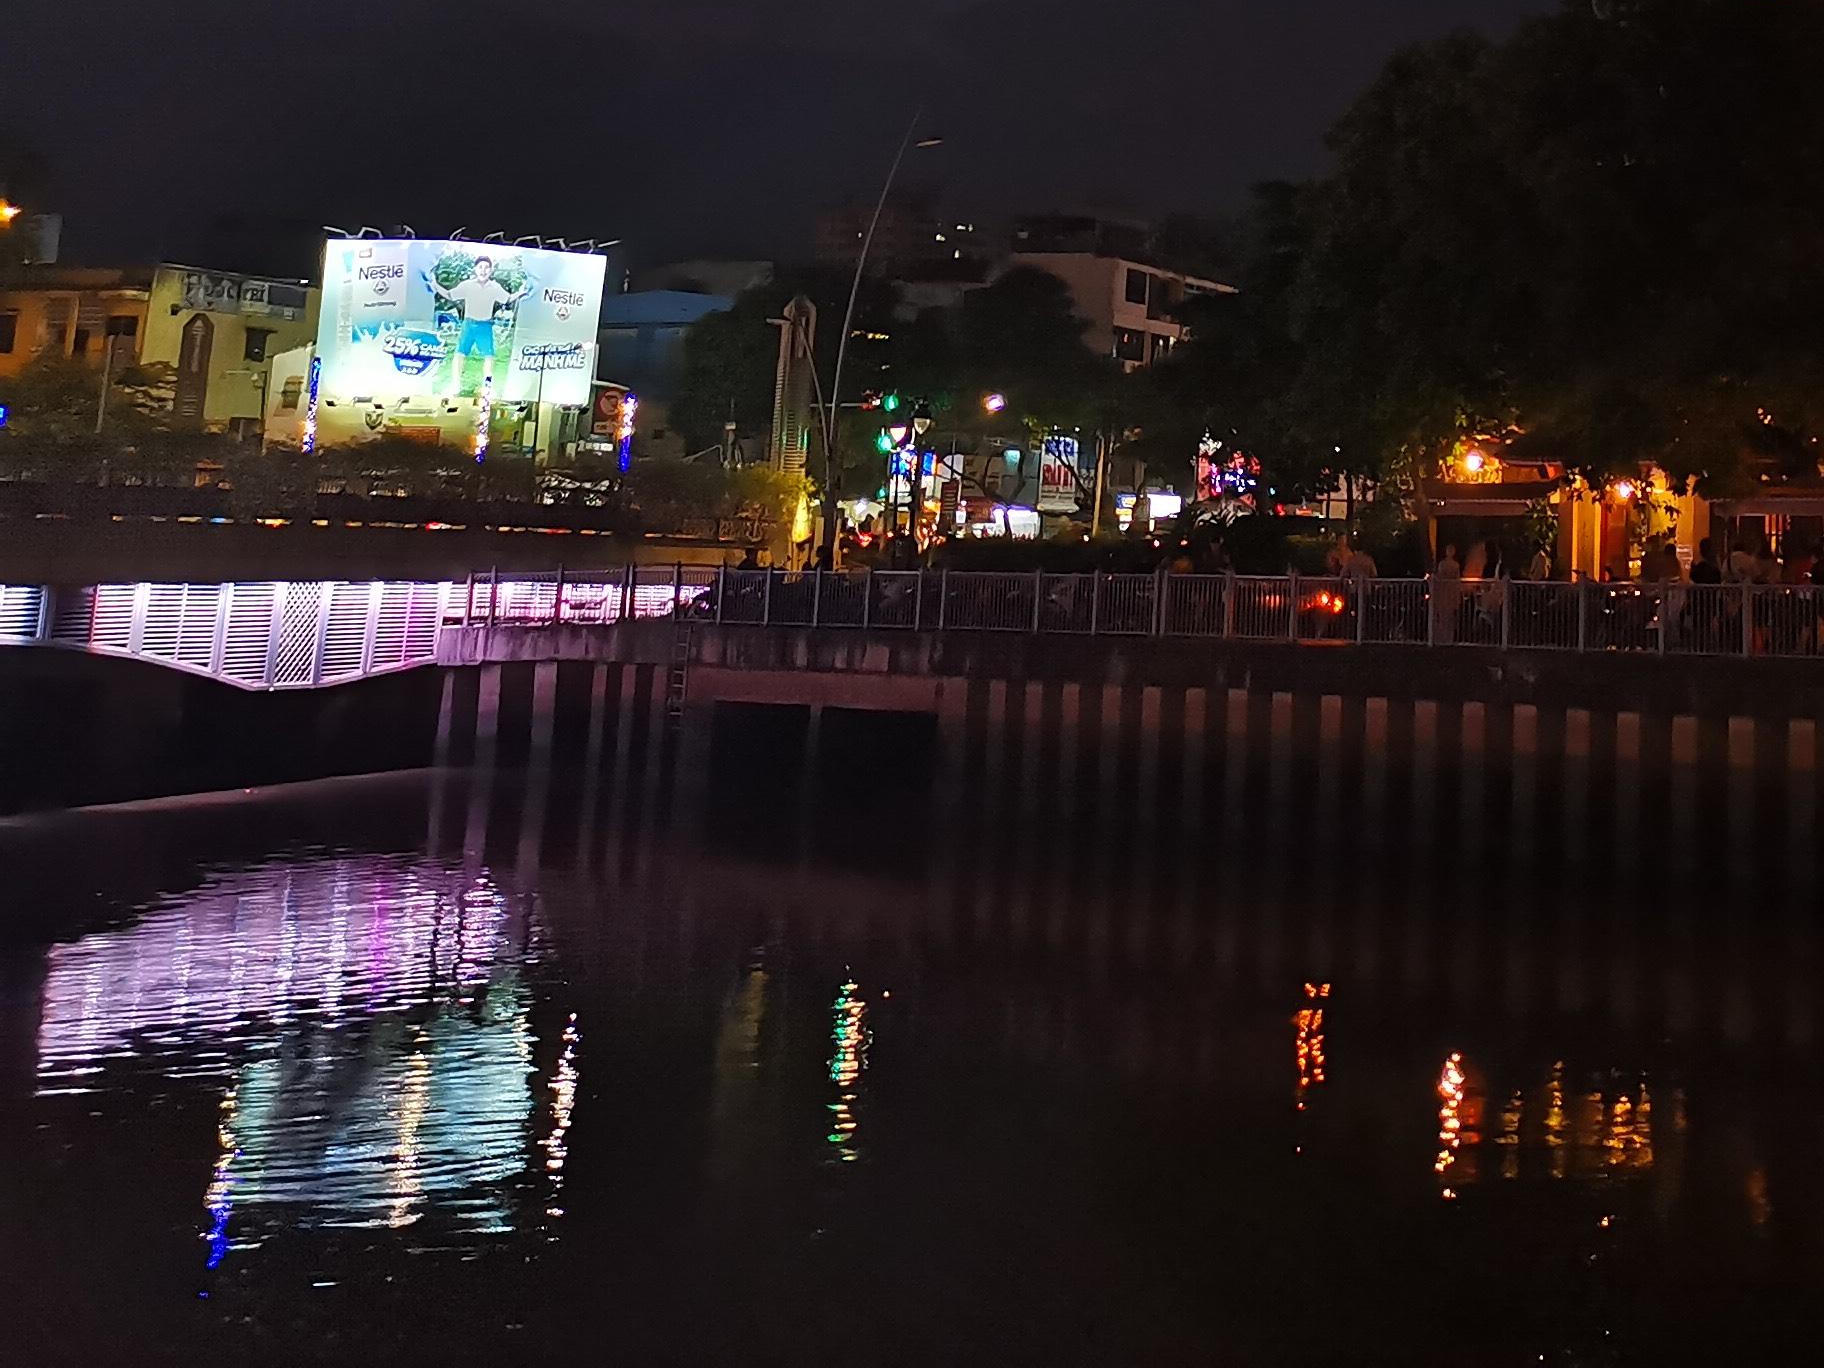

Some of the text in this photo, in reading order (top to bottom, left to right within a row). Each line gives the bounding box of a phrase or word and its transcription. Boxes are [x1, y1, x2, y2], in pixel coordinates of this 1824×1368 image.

[359, 264, 404, 281] Nestlé
[543, 288, 584, 306] Nestlé
[384, 335, 421, 356] 25%
